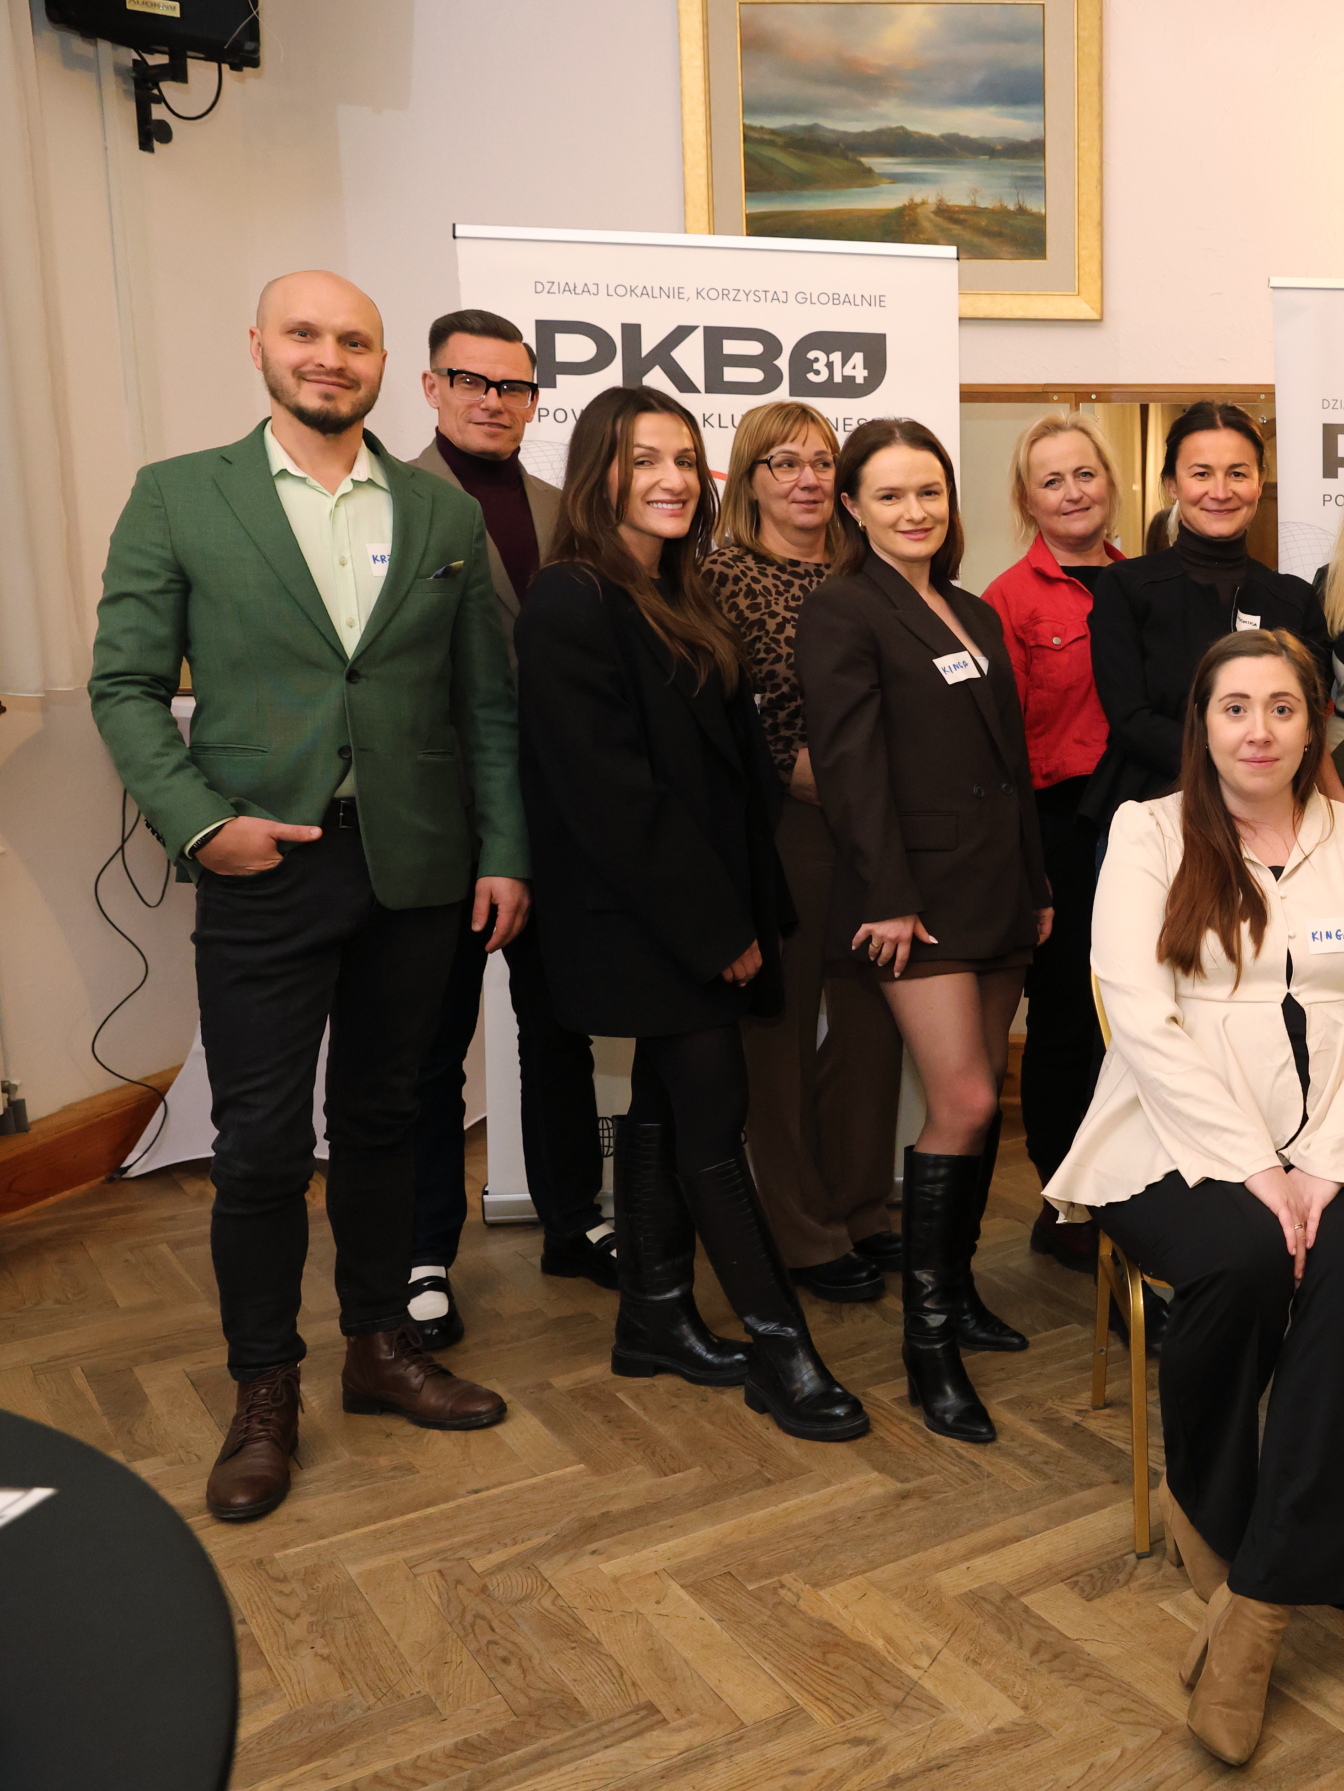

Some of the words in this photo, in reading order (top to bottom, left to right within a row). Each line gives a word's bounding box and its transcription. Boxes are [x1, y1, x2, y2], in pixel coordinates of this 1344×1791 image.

[534, 281, 600, 297] DZIAŁAJ
[606, 283, 691, 302] LOKALNIE,
[695, 287, 789, 304] KORZYSTAJ
[795, 291, 887, 308] GLOBALNIE
[535, 319, 784, 395] PKB
[806, 349, 869, 384] 314
[703, 413, 744, 429] KLU
[941, 660, 969, 675] KINGA
